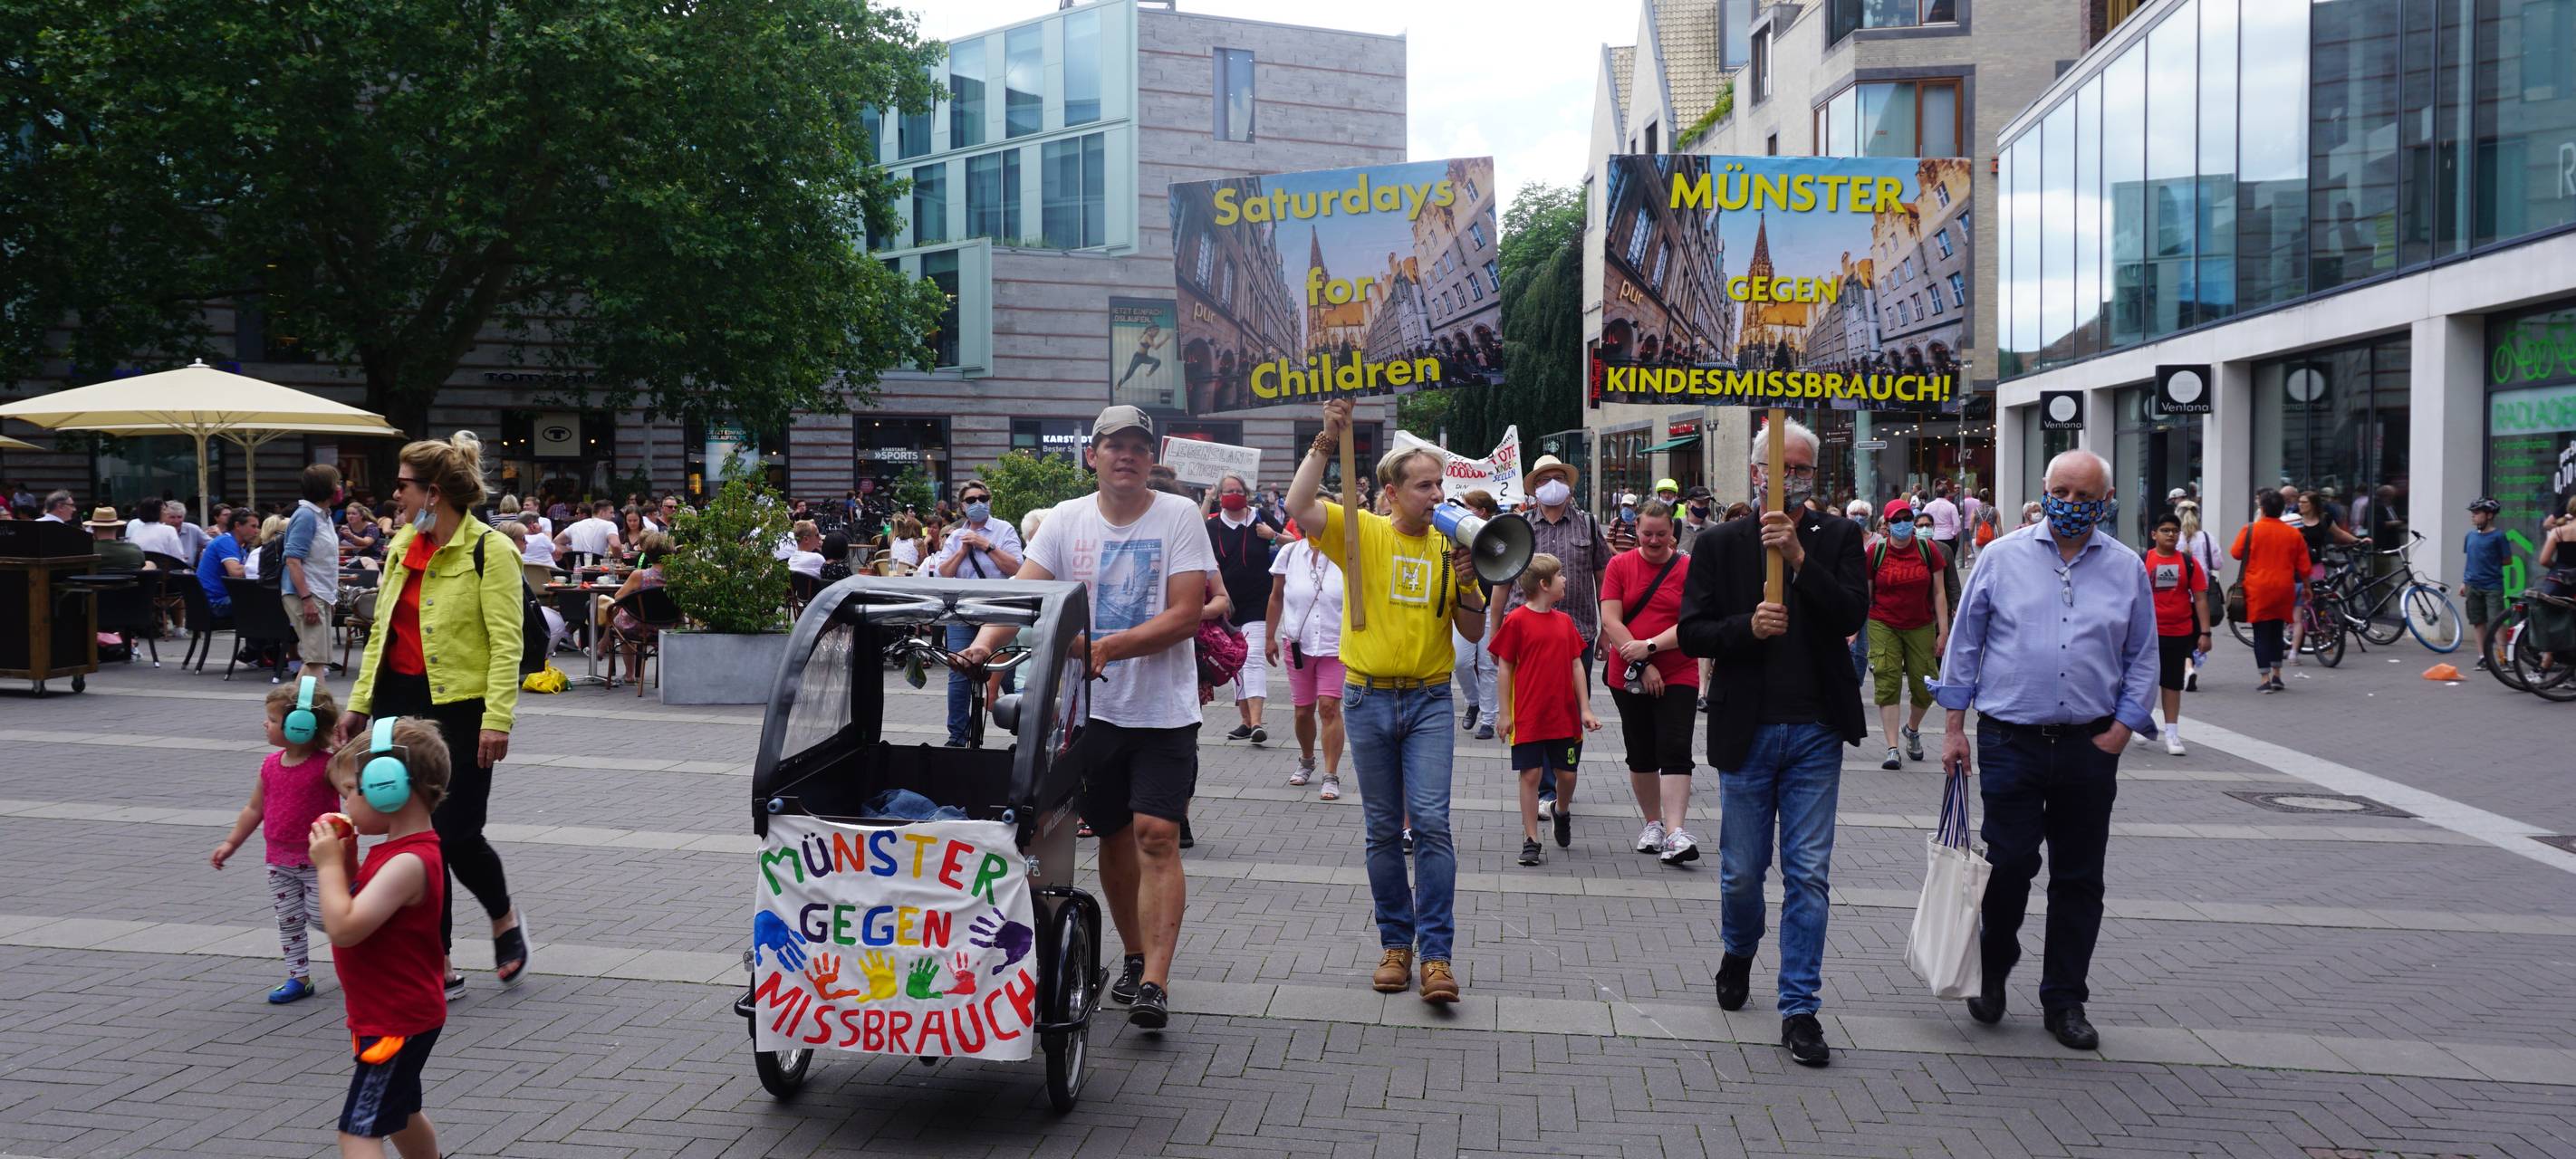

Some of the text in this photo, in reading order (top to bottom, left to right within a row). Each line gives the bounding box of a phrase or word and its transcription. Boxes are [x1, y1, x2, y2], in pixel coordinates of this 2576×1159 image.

[1215, 173, 1455, 225] Saturdays
[1669, 164, 1906, 214] MÜNSTER
[1306, 266, 1374, 306] for
[1619, 279, 1644, 306] pur
[1727, 275, 1838, 303] GEGEN
[1193, 302, 1216, 324] pur
[1250, 351, 1440, 399] Children
[1607, 366, 1951, 403] KINDESMISSBRAUCH!
[2044, 419, 2082, 429] Ventana
[2162, 401, 2209, 413] Ventana
[881, 452, 918, 460] SPORTS
[761, 829, 1008, 905] MÜNSTER
[800, 903, 952, 948] GEGEN
[755, 968, 1036, 1056] MISSBRAUCH
